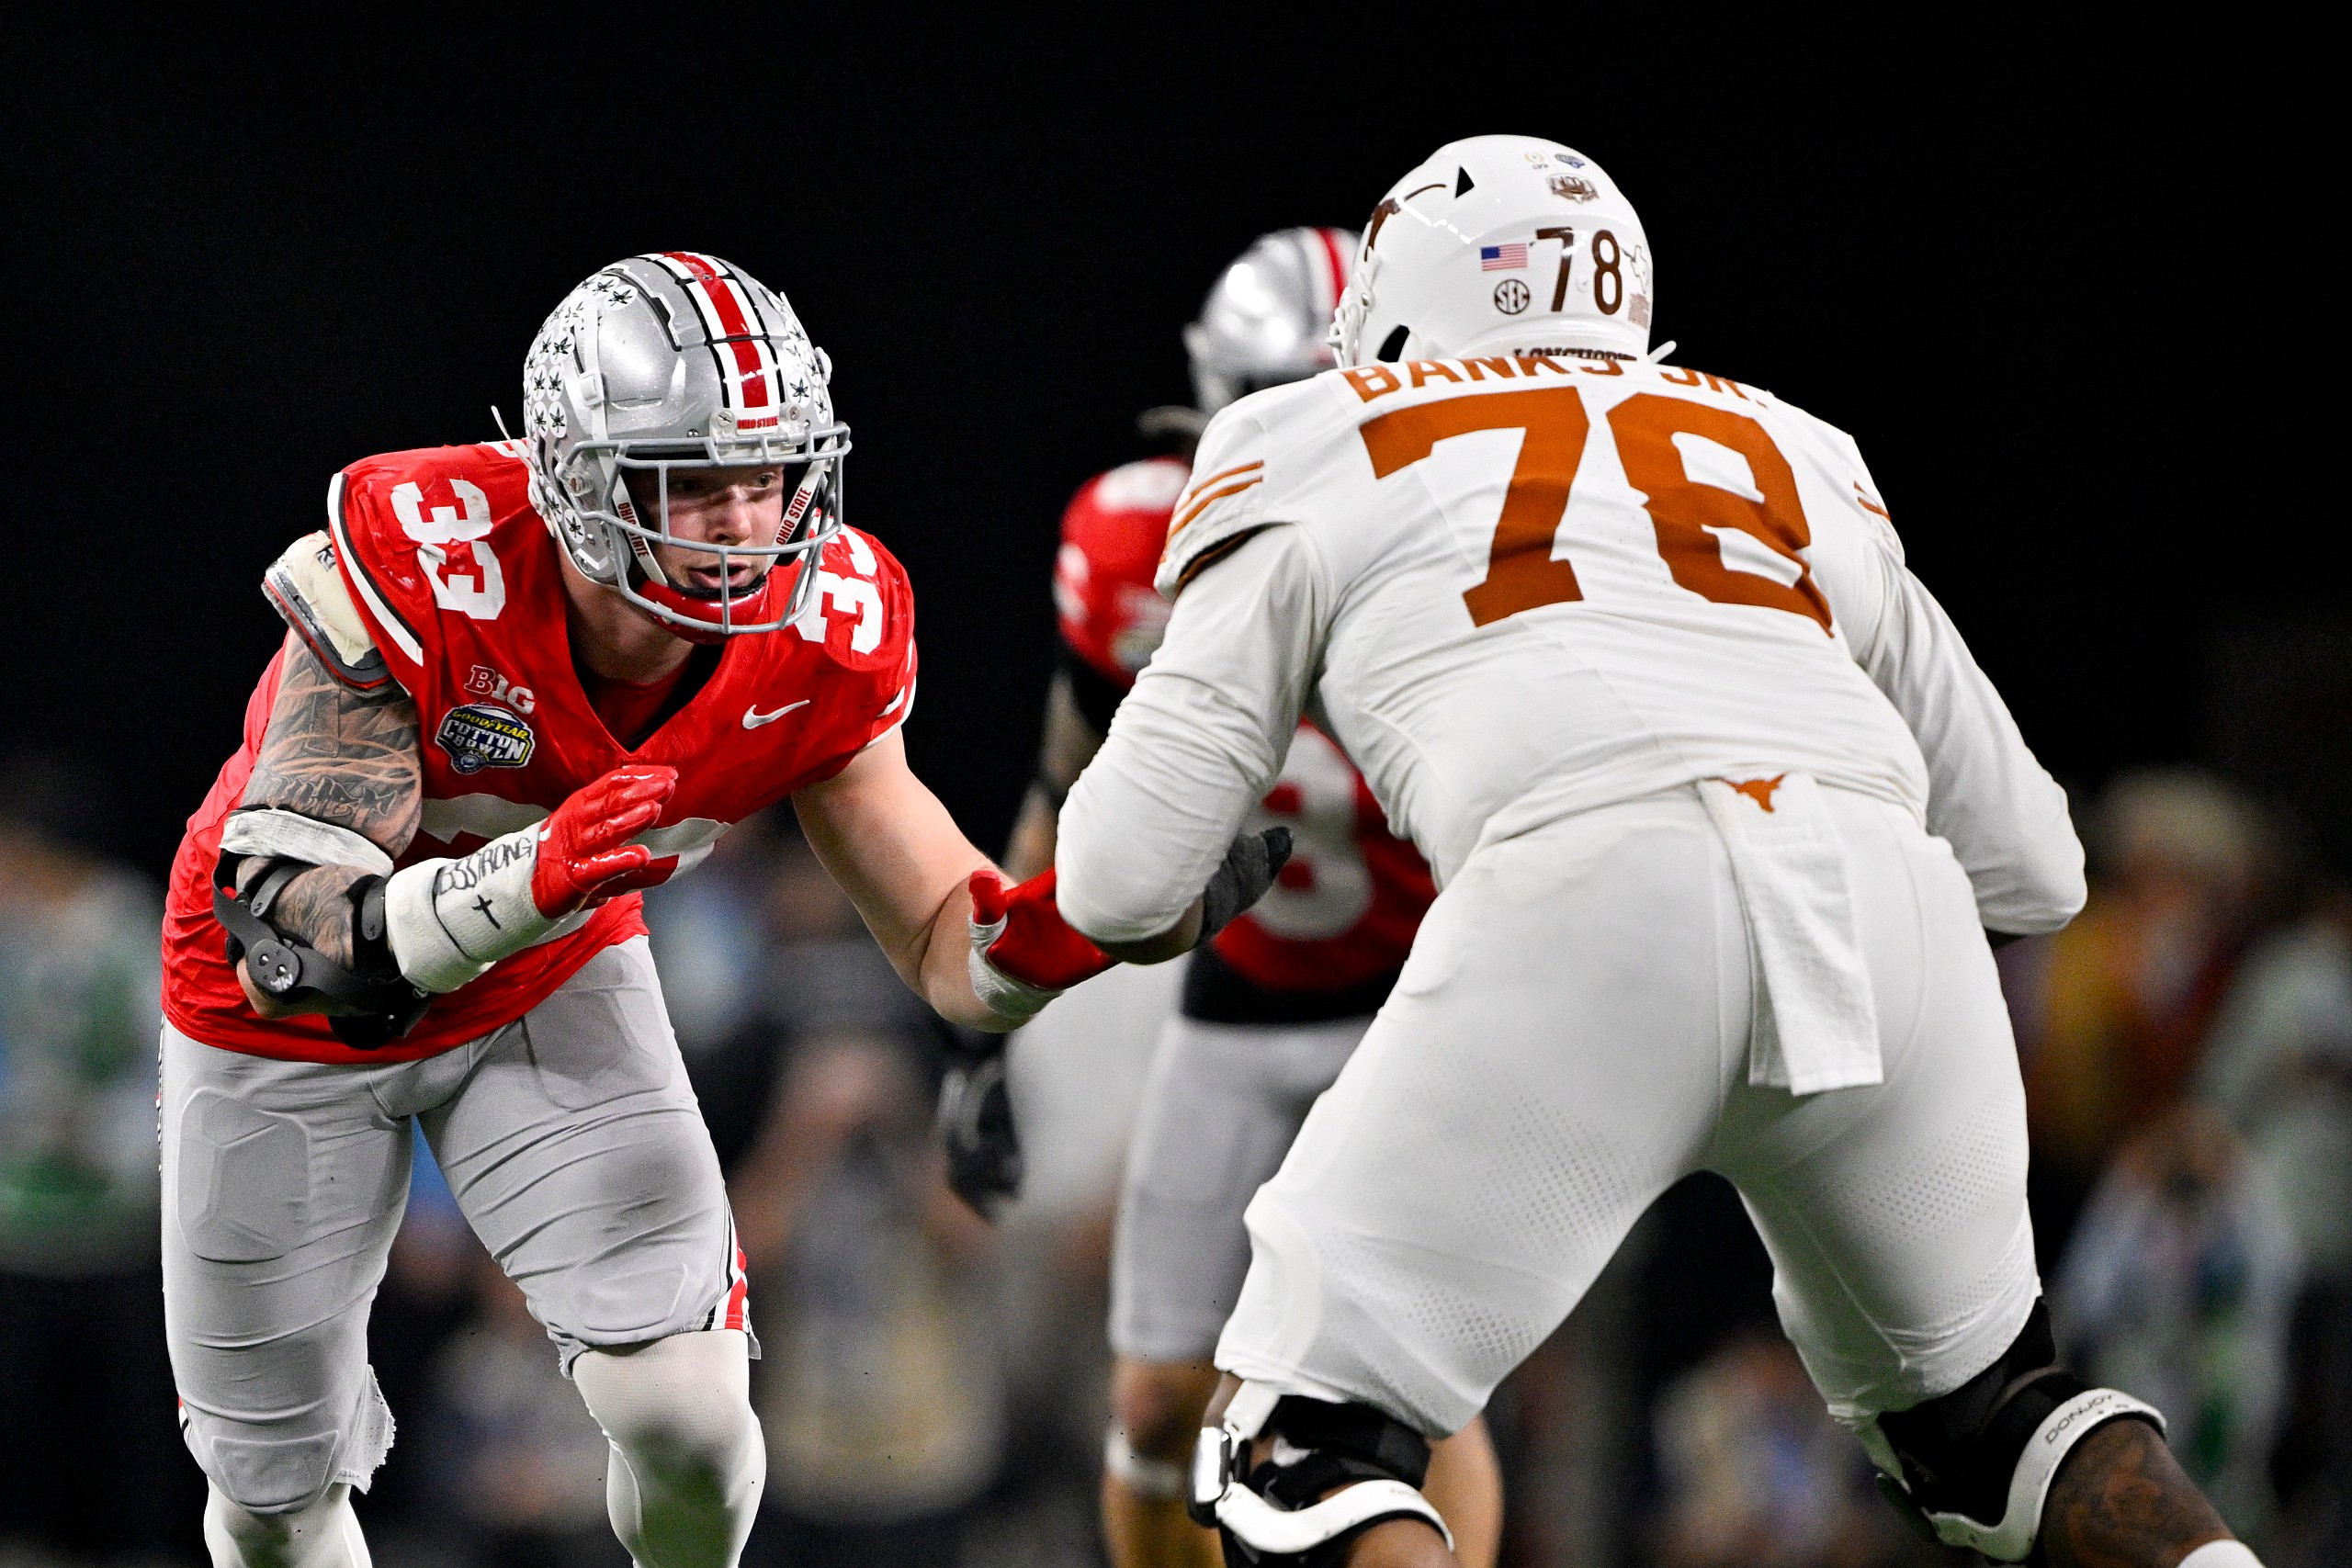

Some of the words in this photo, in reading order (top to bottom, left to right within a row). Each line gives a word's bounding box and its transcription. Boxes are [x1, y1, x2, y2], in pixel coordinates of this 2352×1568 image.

[1494, 279, 1531, 314] SEC
[1535, 226, 1623, 316] 78
[775, 519, 796, 546] OHIO
[787, 487, 812, 520] STATE
[1359, 385, 1836, 638] 78
[390, 478, 506, 621] 33
[795, 507, 884, 655] 33
[443, 719, 526, 760] COTTON
[452, 710, 529, 740] GOODYEAR
[453, 736, 504, 760] BOWL
